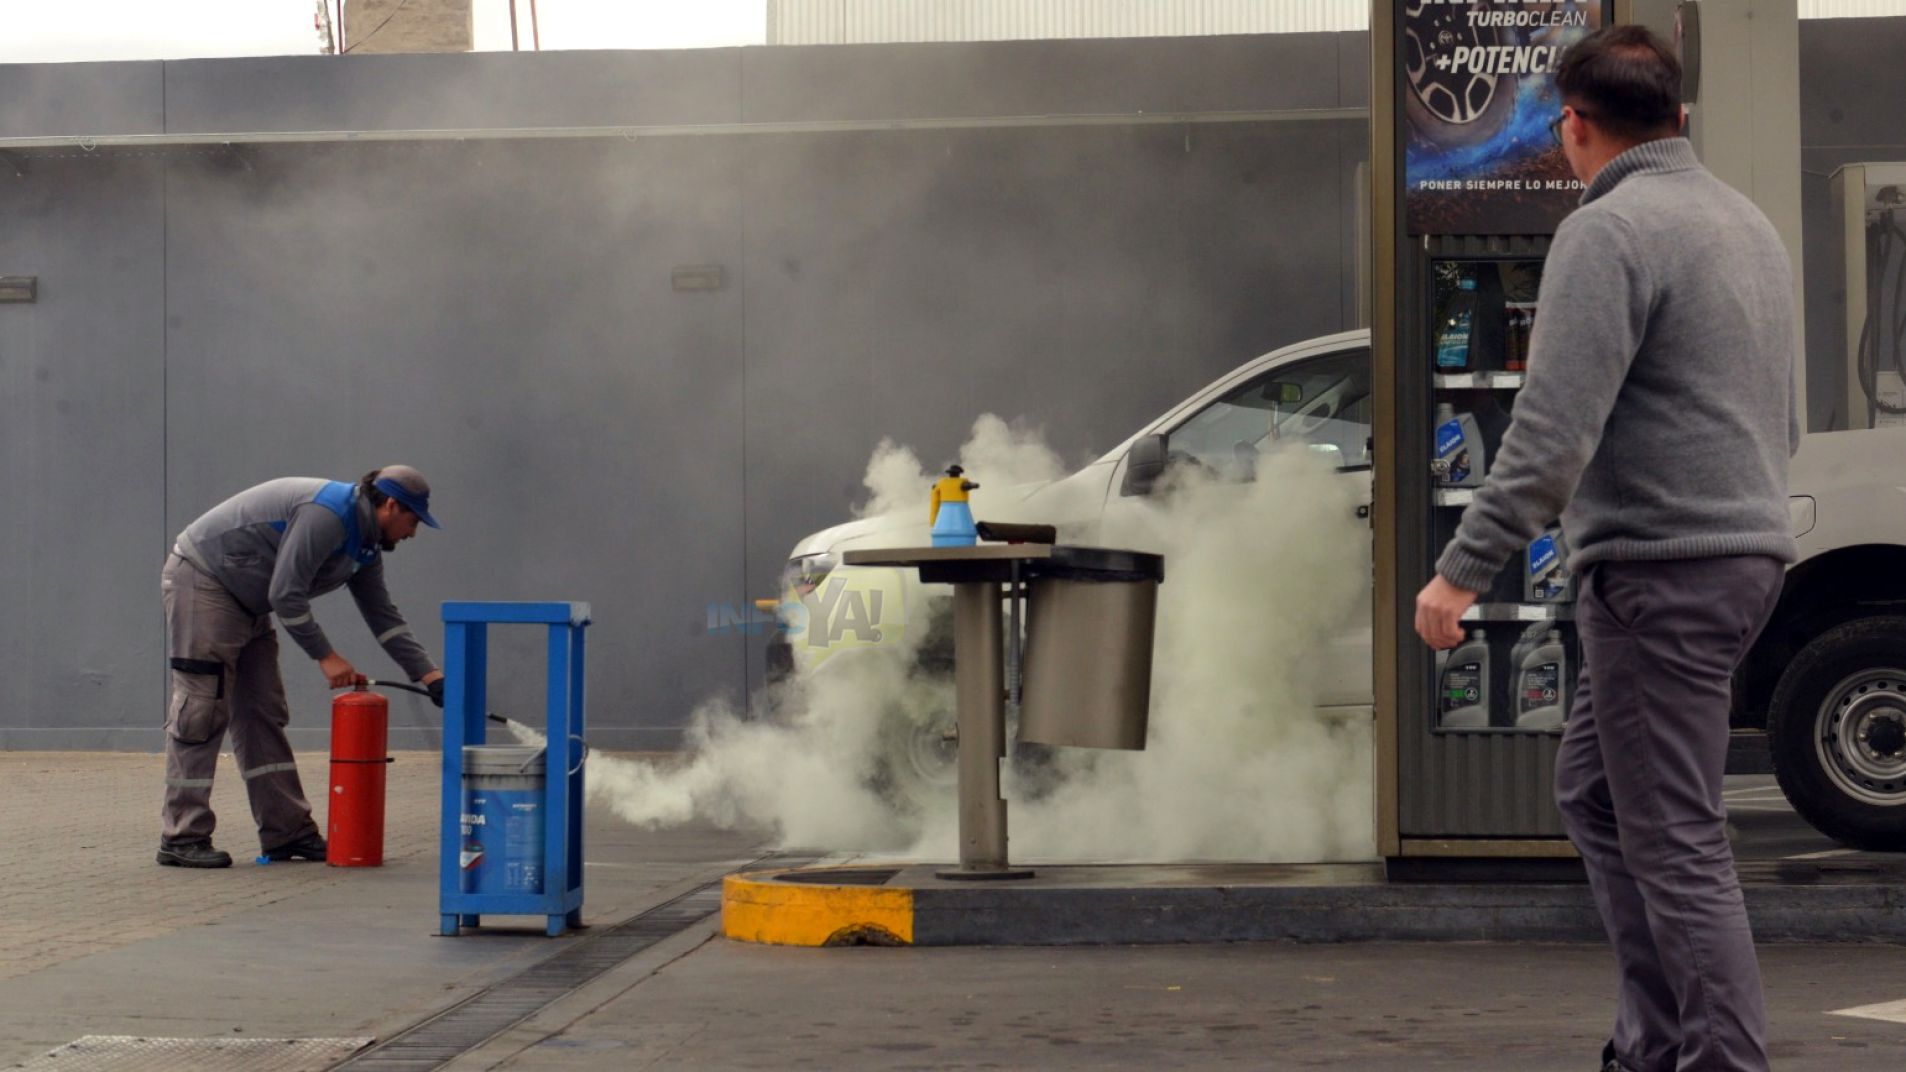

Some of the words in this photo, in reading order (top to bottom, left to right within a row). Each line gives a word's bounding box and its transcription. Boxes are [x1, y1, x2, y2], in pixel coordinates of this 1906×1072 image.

[1466, 10, 1588, 27] TURBOCLEAN
[1419, 180, 1462, 190] PONER
[1466, 180, 1521, 190] SIEMPRE
[1525, 180, 1541, 190] LO
